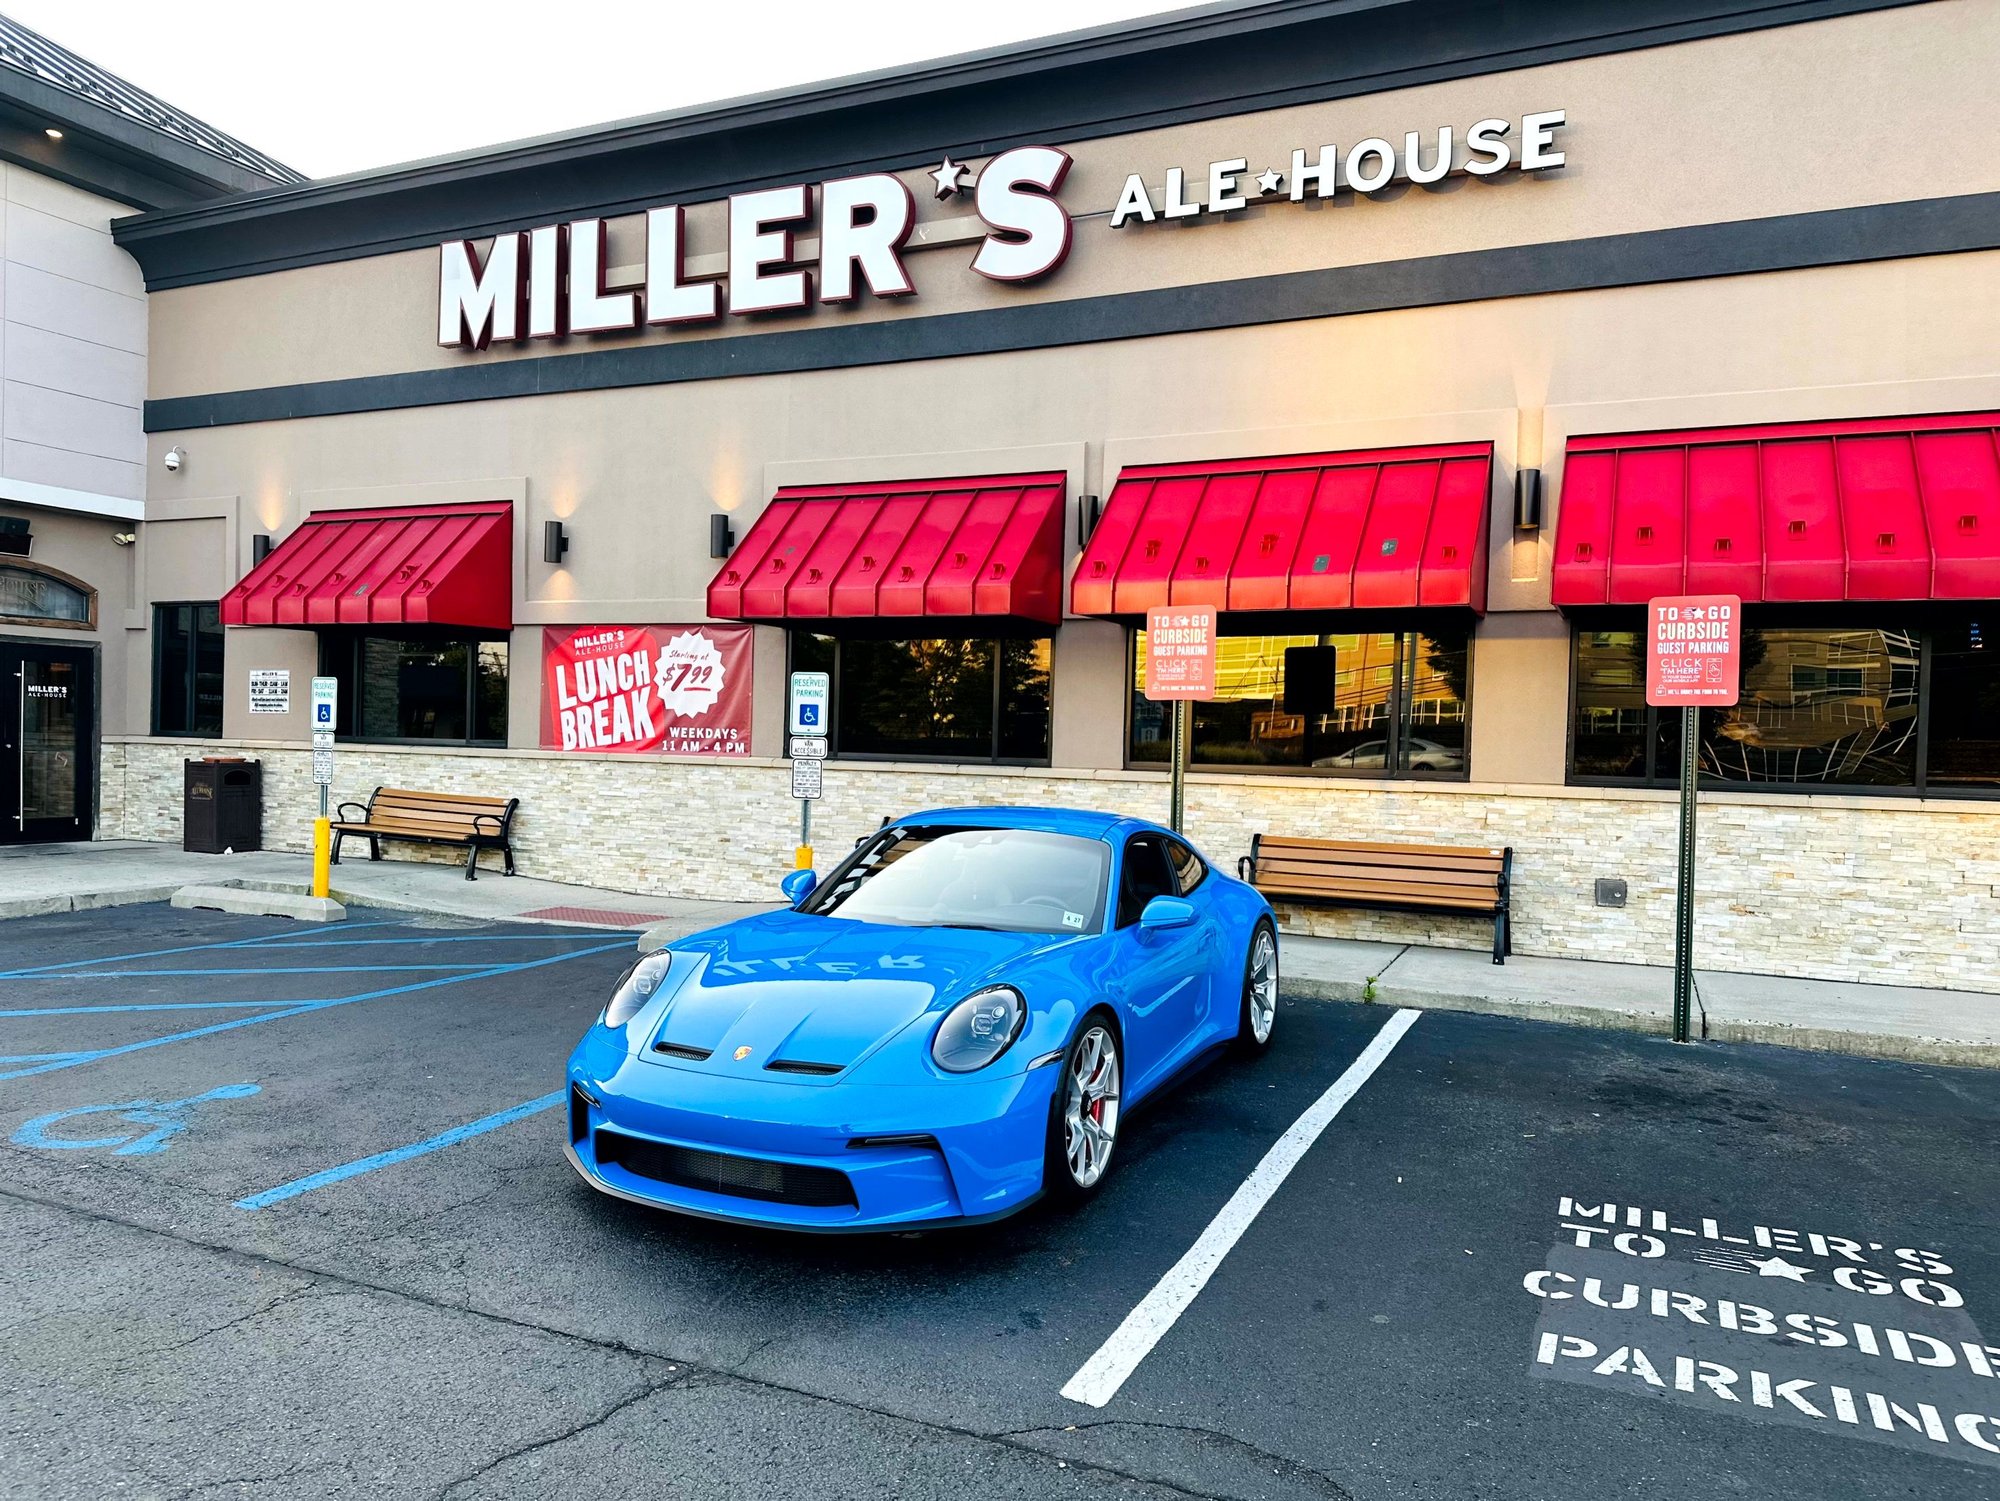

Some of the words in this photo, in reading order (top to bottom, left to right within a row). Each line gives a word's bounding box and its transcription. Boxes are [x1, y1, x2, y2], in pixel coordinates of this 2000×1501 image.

[438, 145, 1074, 350] MILLER'S
[1657, 607, 1679, 621] TO
[1708, 605, 1731, 620] GO
[1153, 615, 1170, 628] TO
[1191, 614, 1209, 628] GO
[1153, 628, 1208, 644] CURBSIDE
[1657, 621, 1729, 640] CURBSIDE
[574, 630, 625, 649] MILLER'S
[1153, 645, 1175, 657] GUEST
[1177, 644, 1208, 656] PARKING
[1657, 642, 1686, 655] GUEST
[1688, 641, 1729, 654] PARKING
[669, 650, 698, 662] Starting
[700, 652, 709, 661] at
[1661, 658, 1702, 668] CLICK
[1156, 659, 1187, 668] CLICK
[555, 650, 650, 710] LUNCH
[794, 678, 826, 688] RESERVED
[27, 684, 68, 694] MILLER'S
[796, 689, 823, 698] PARKING
[560, 686, 656, 751] BREAK
[669, 726, 738, 740] WEEKDAYS
[662, 740, 676, 751] 11
[681, 741, 700, 753] AM
[713, 741, 721, 753] 4
[726, 742, 745, 754] PM
[794, 747, 823, 755] ACCESSIBLE
[1557, 1196, 1954, 1276] MILLER'S
[1560, 1222, 1666, 1259] TO
[1832, 1266, 1965, 1309] GO
